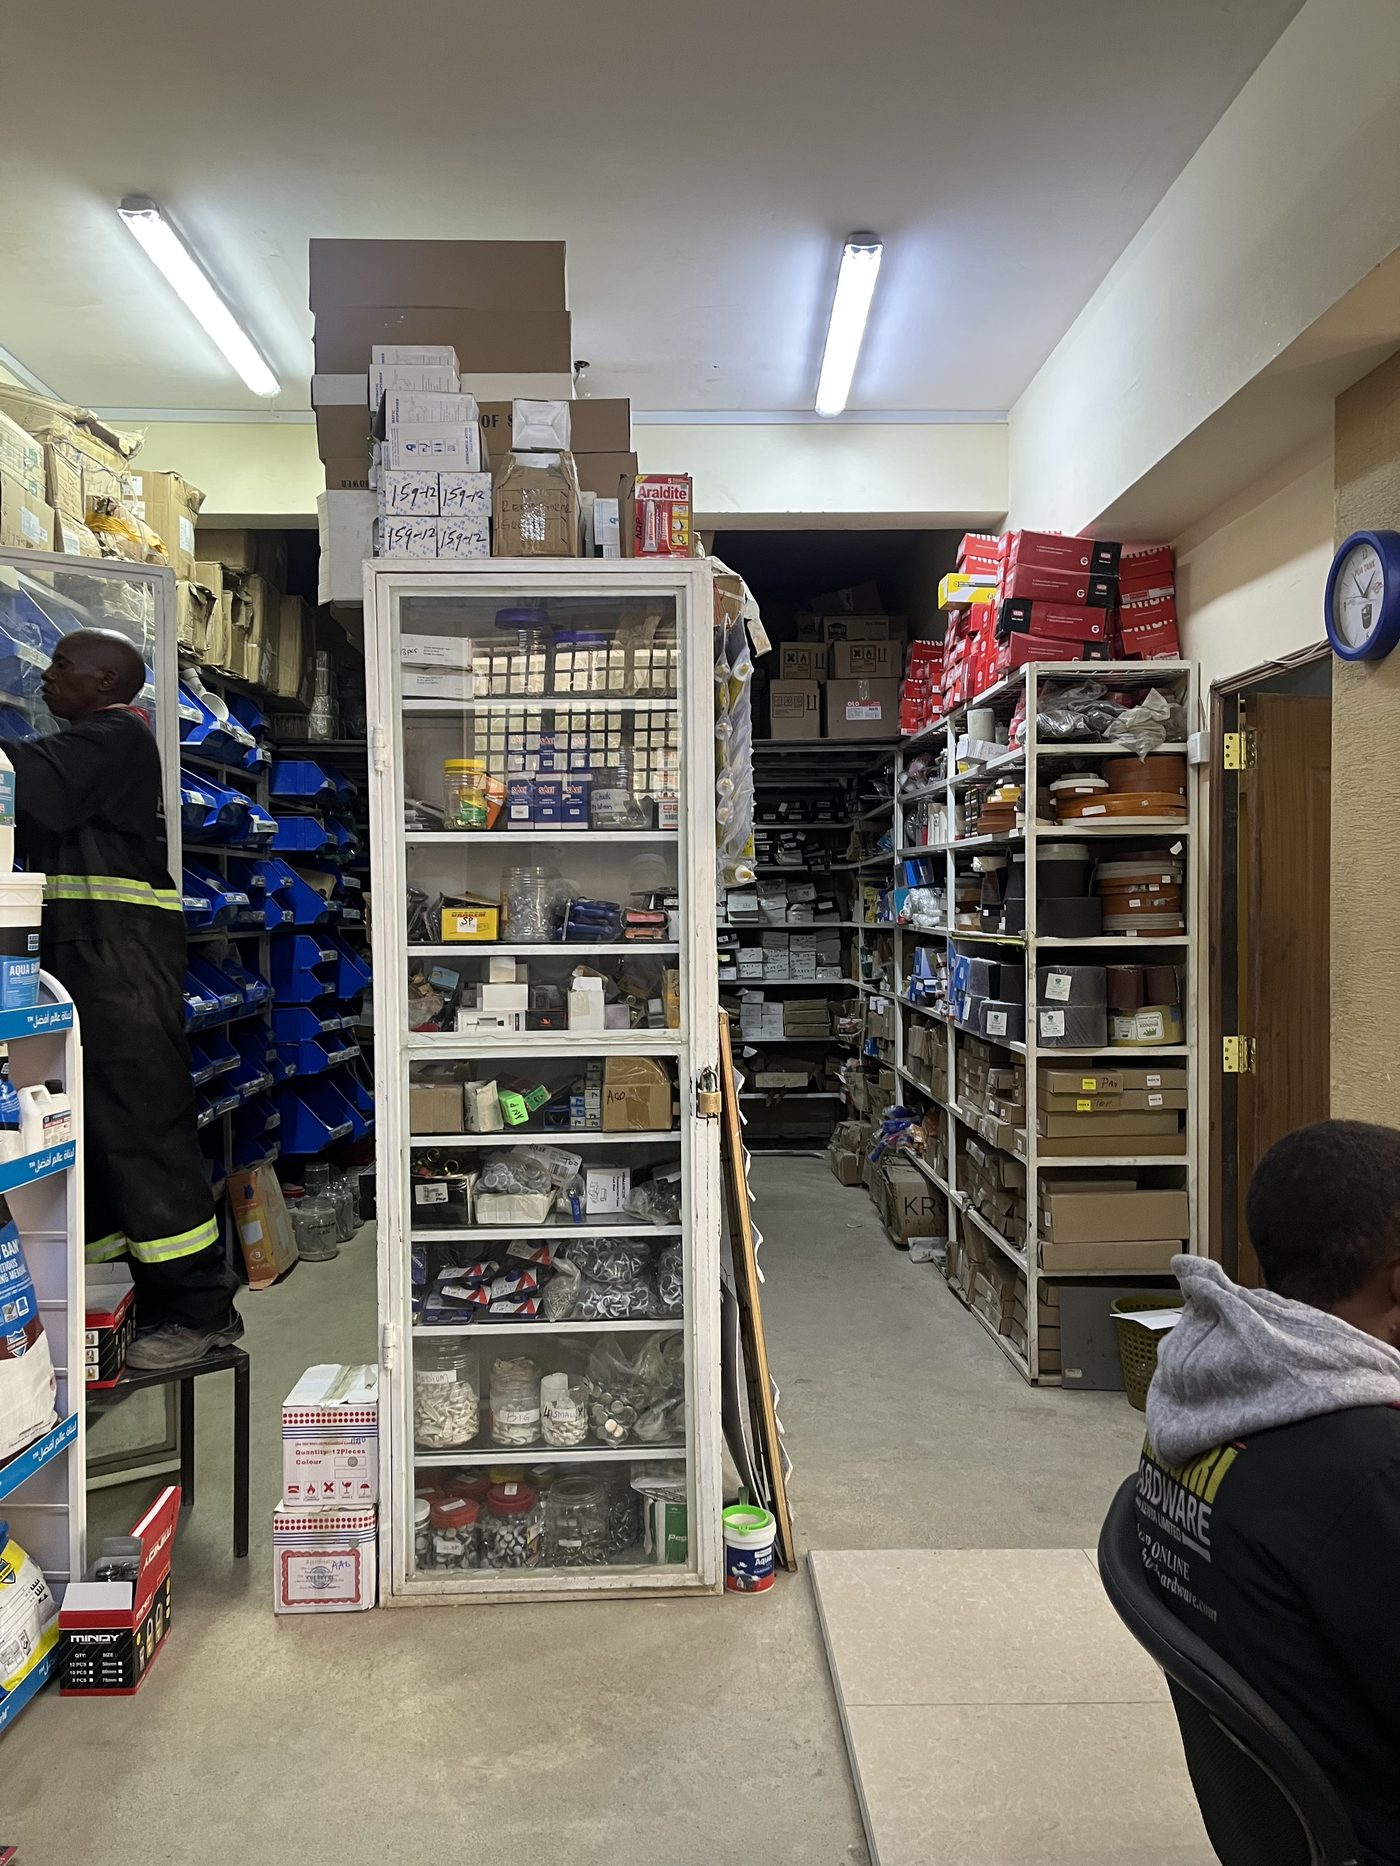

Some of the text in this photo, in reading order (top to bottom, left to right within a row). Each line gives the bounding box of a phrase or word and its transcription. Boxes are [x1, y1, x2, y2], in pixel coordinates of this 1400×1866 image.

[482, 414, 499, 428] OF
[637, 486, 687, 500] Araldite
[1080, 557, 1089, 566] G
[1076, 589, 1085, 598] G
[1091, 624, 1100, 633] G
[9, 964, 30, 977] AQUA
[1136, 1458, 1212, 1546] ARDWARE
[754, 1554, 773, 1566] Aqua
[1151, 1541, 1190, 1582] ONLINE
